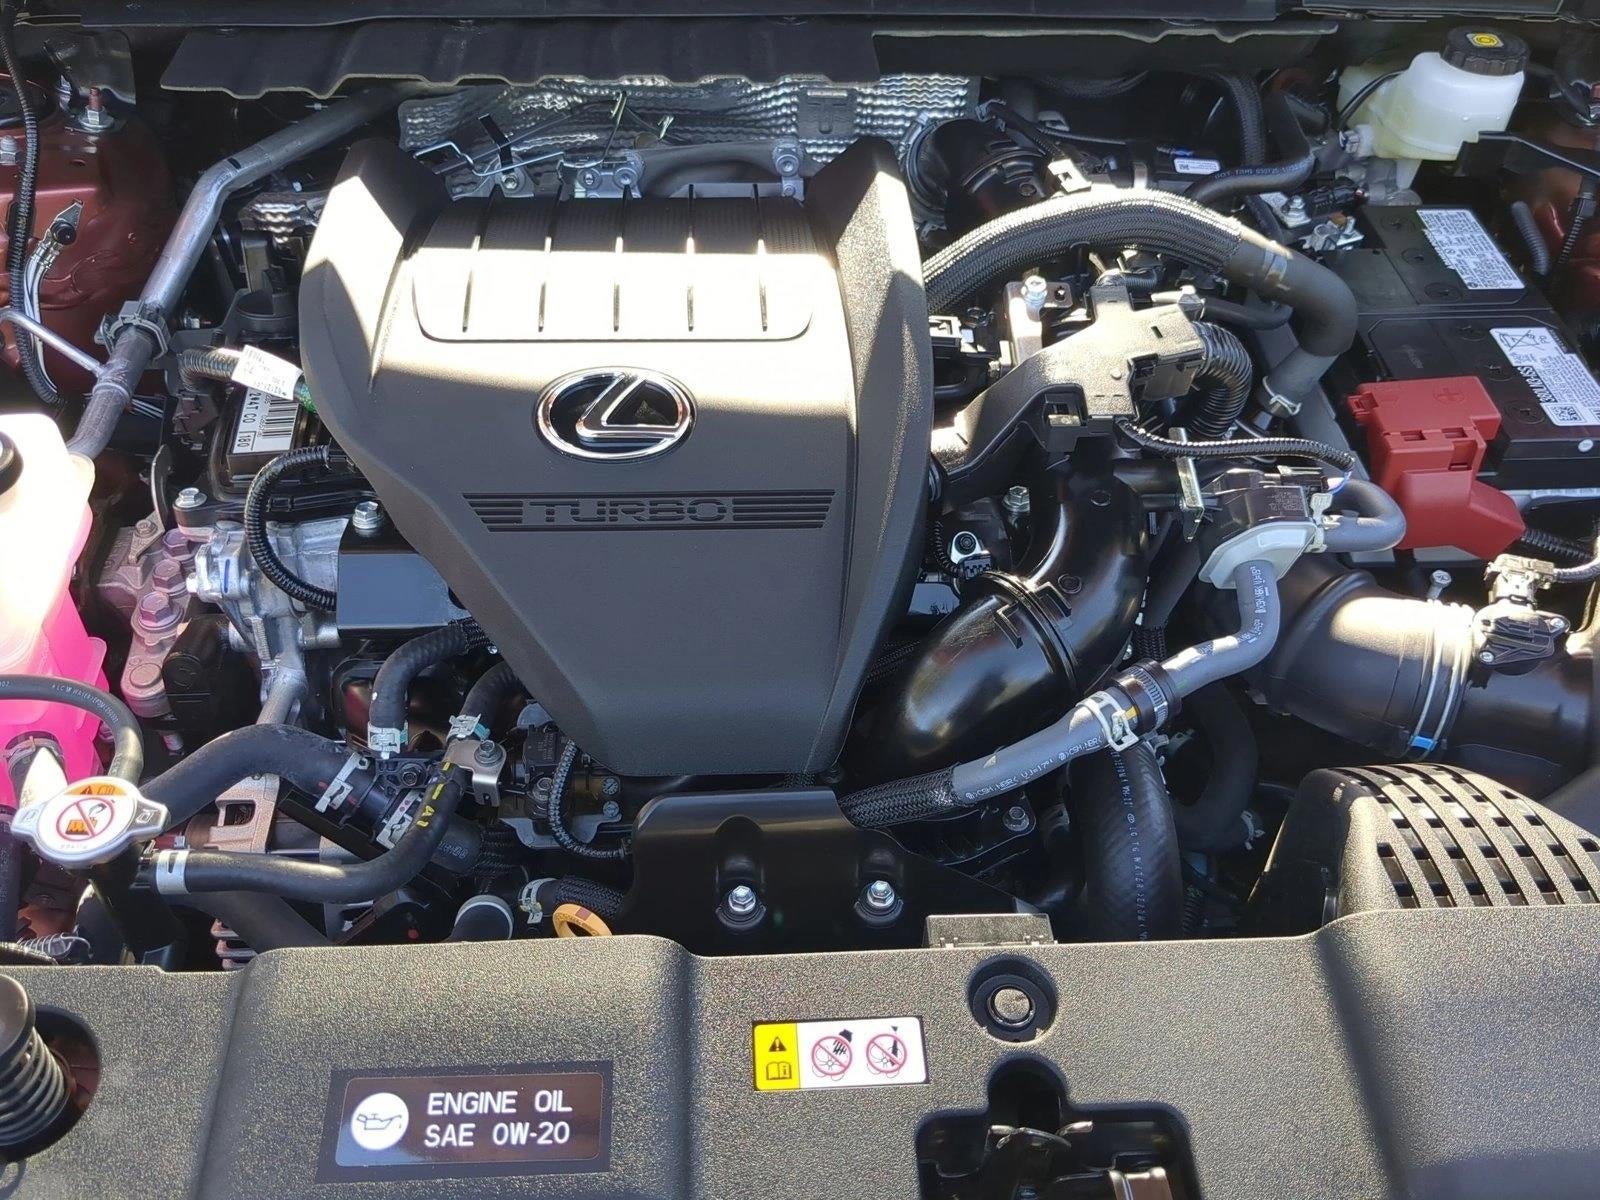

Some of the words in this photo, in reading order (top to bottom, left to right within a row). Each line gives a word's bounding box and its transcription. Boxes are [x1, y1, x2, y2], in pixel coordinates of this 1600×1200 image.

[529, 498, 728, 522] TURBO
[426, 1091, 519, 1116] ENGINE
[534, 1090, 573, 1113] OIL
[423, 1123, 475, 1148] SAE
